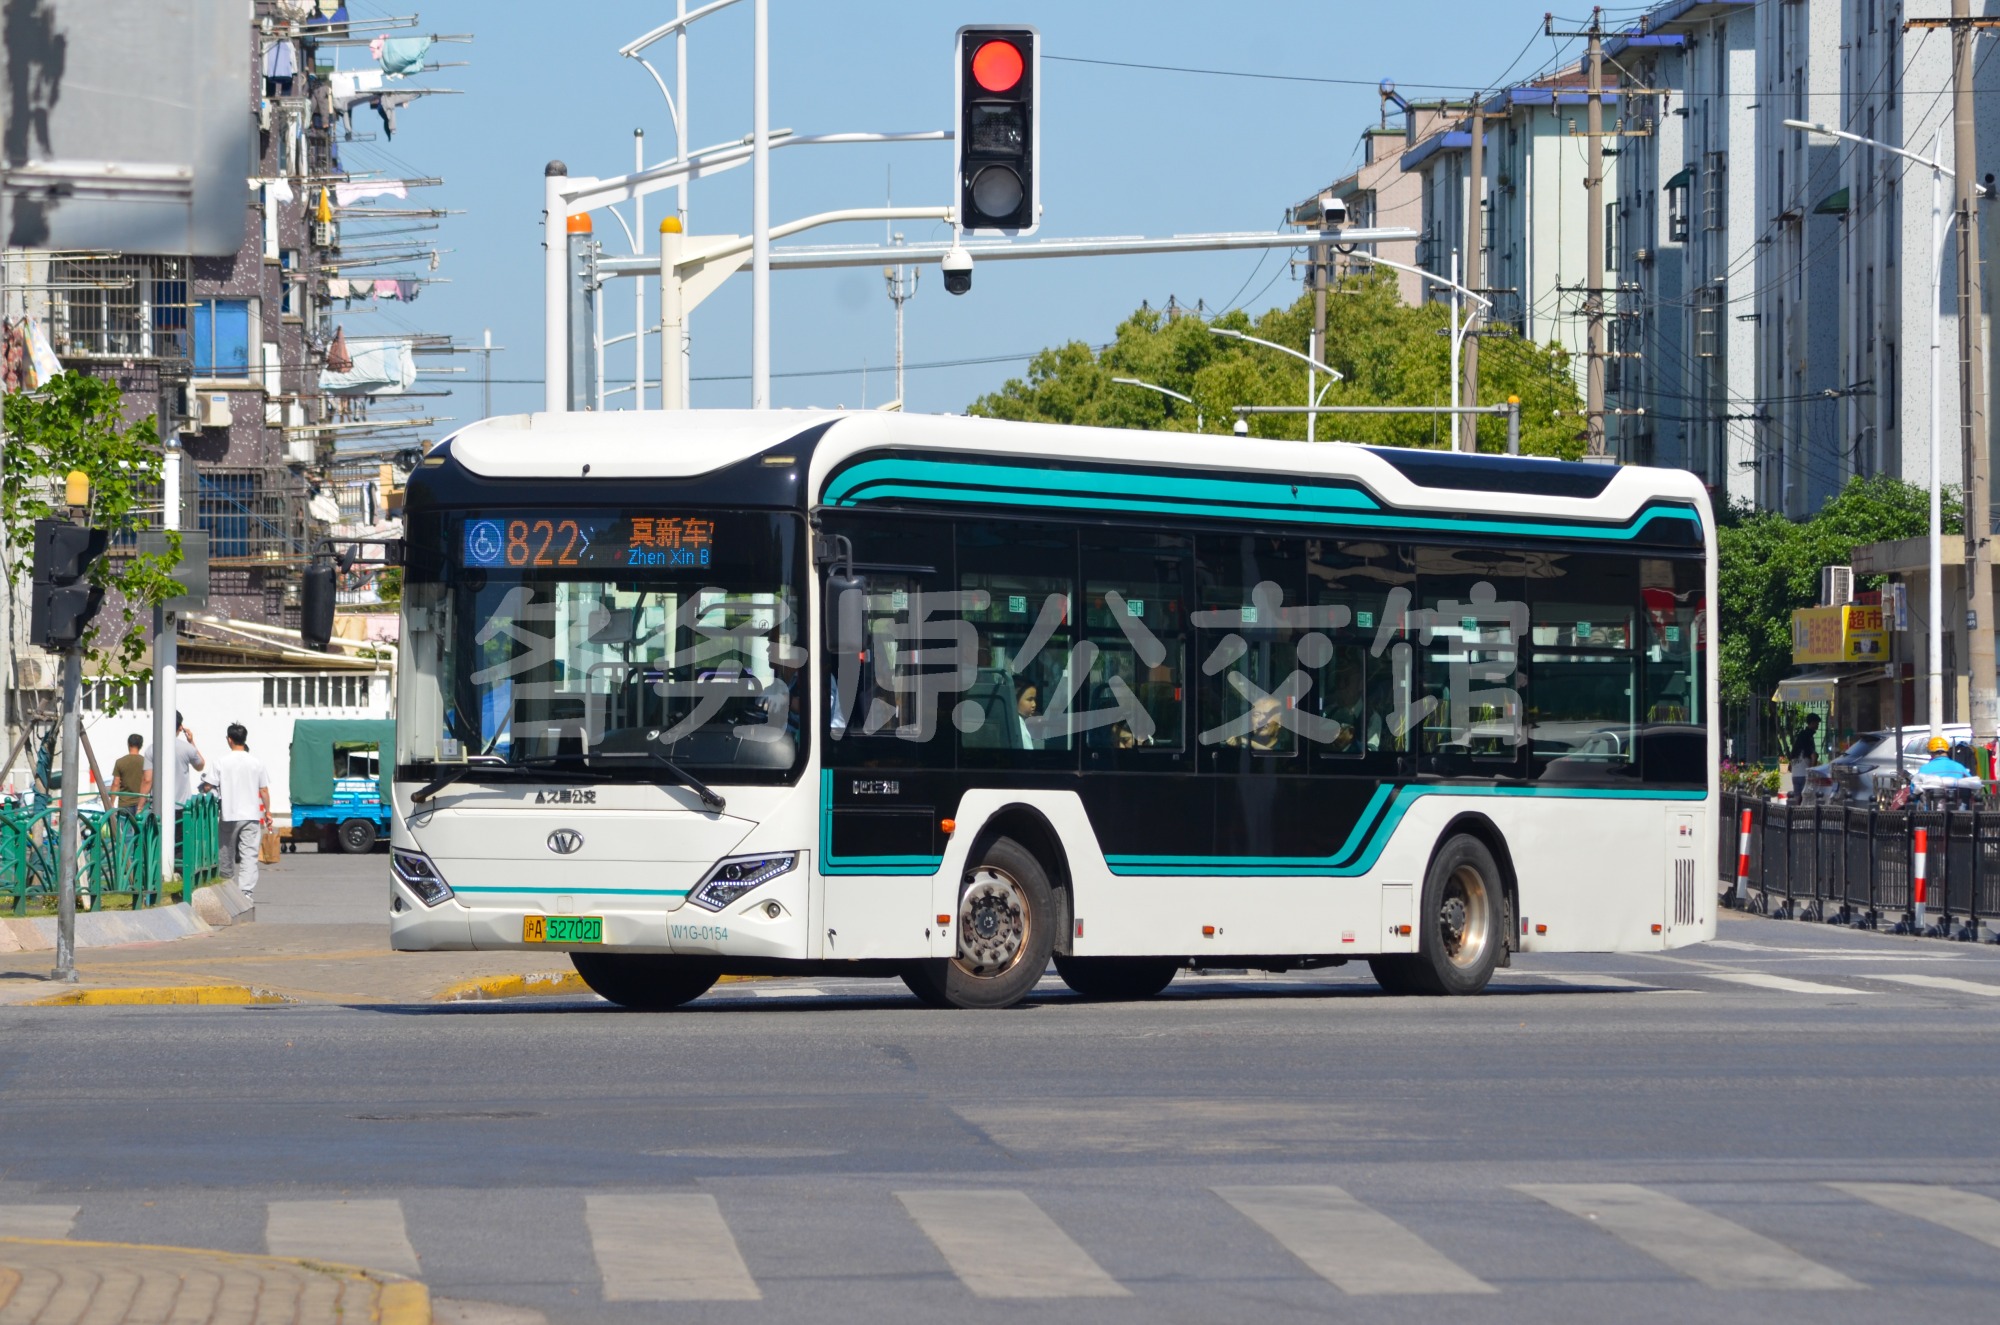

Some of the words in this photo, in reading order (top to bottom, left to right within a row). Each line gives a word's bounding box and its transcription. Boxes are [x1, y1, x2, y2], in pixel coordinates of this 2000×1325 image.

[507, 520, 579, 566] 822
[628, 547, 665, 565] Zhen
[670, 548, 695, 565] Xin
[700, 549, 709, 565] B
[1849, 610, 1882, 630] 超市
[671, 924, 728, 941] W1G-0154
